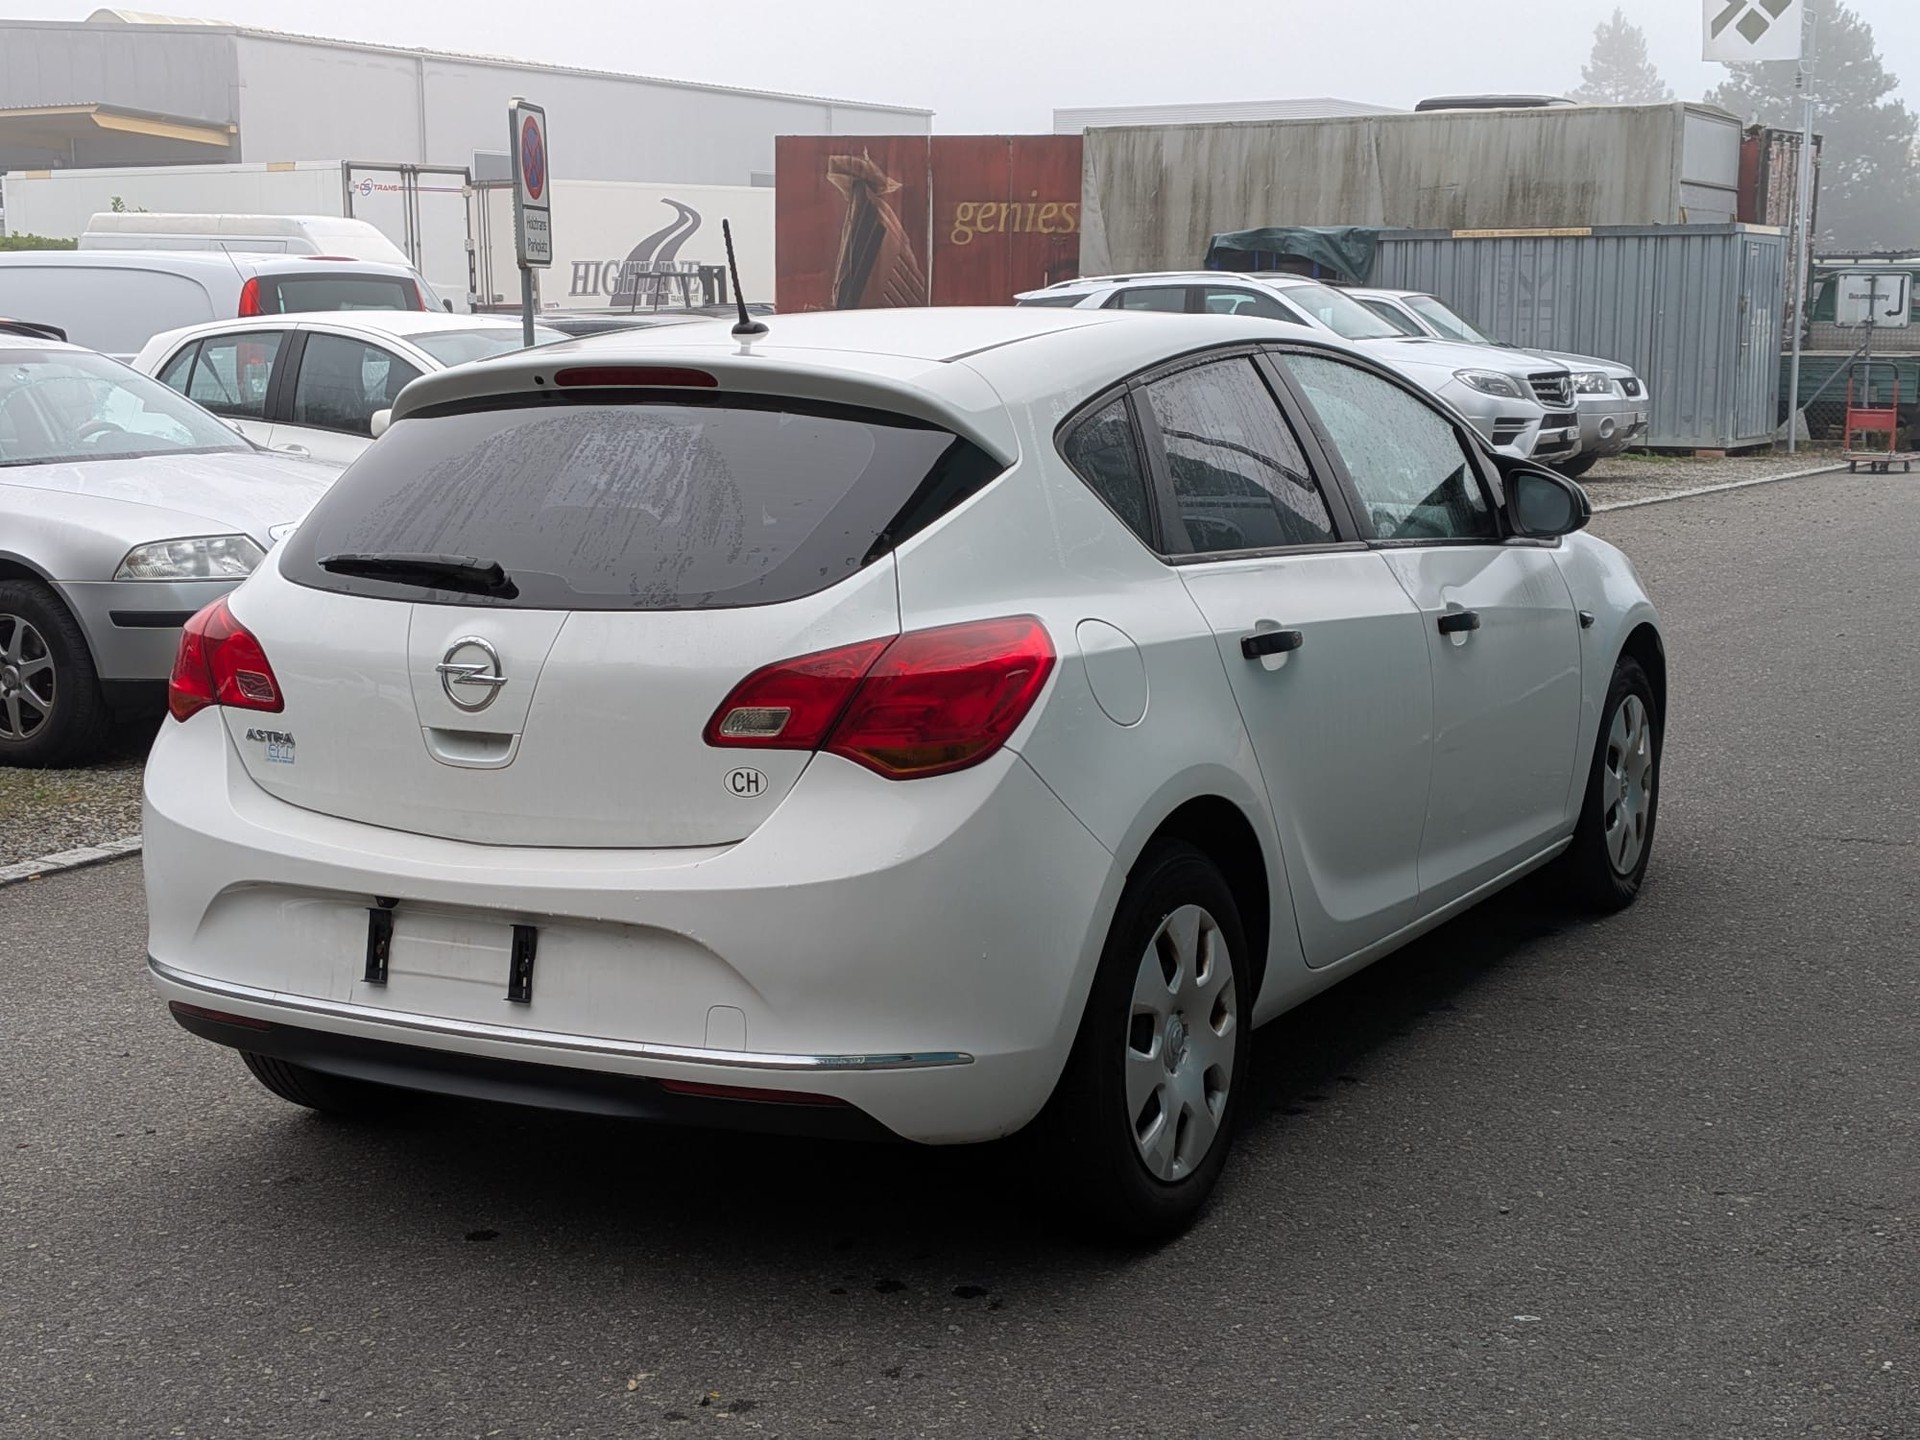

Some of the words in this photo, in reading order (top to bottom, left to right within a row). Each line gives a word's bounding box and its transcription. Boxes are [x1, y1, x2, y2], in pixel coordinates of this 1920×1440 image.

[950, 189, 1081, 245] genies
[527, 237, 548, 255] Parkplatz
[245, 728, 295, 746] ASTRA
[732, 771, 759, 793] CH
